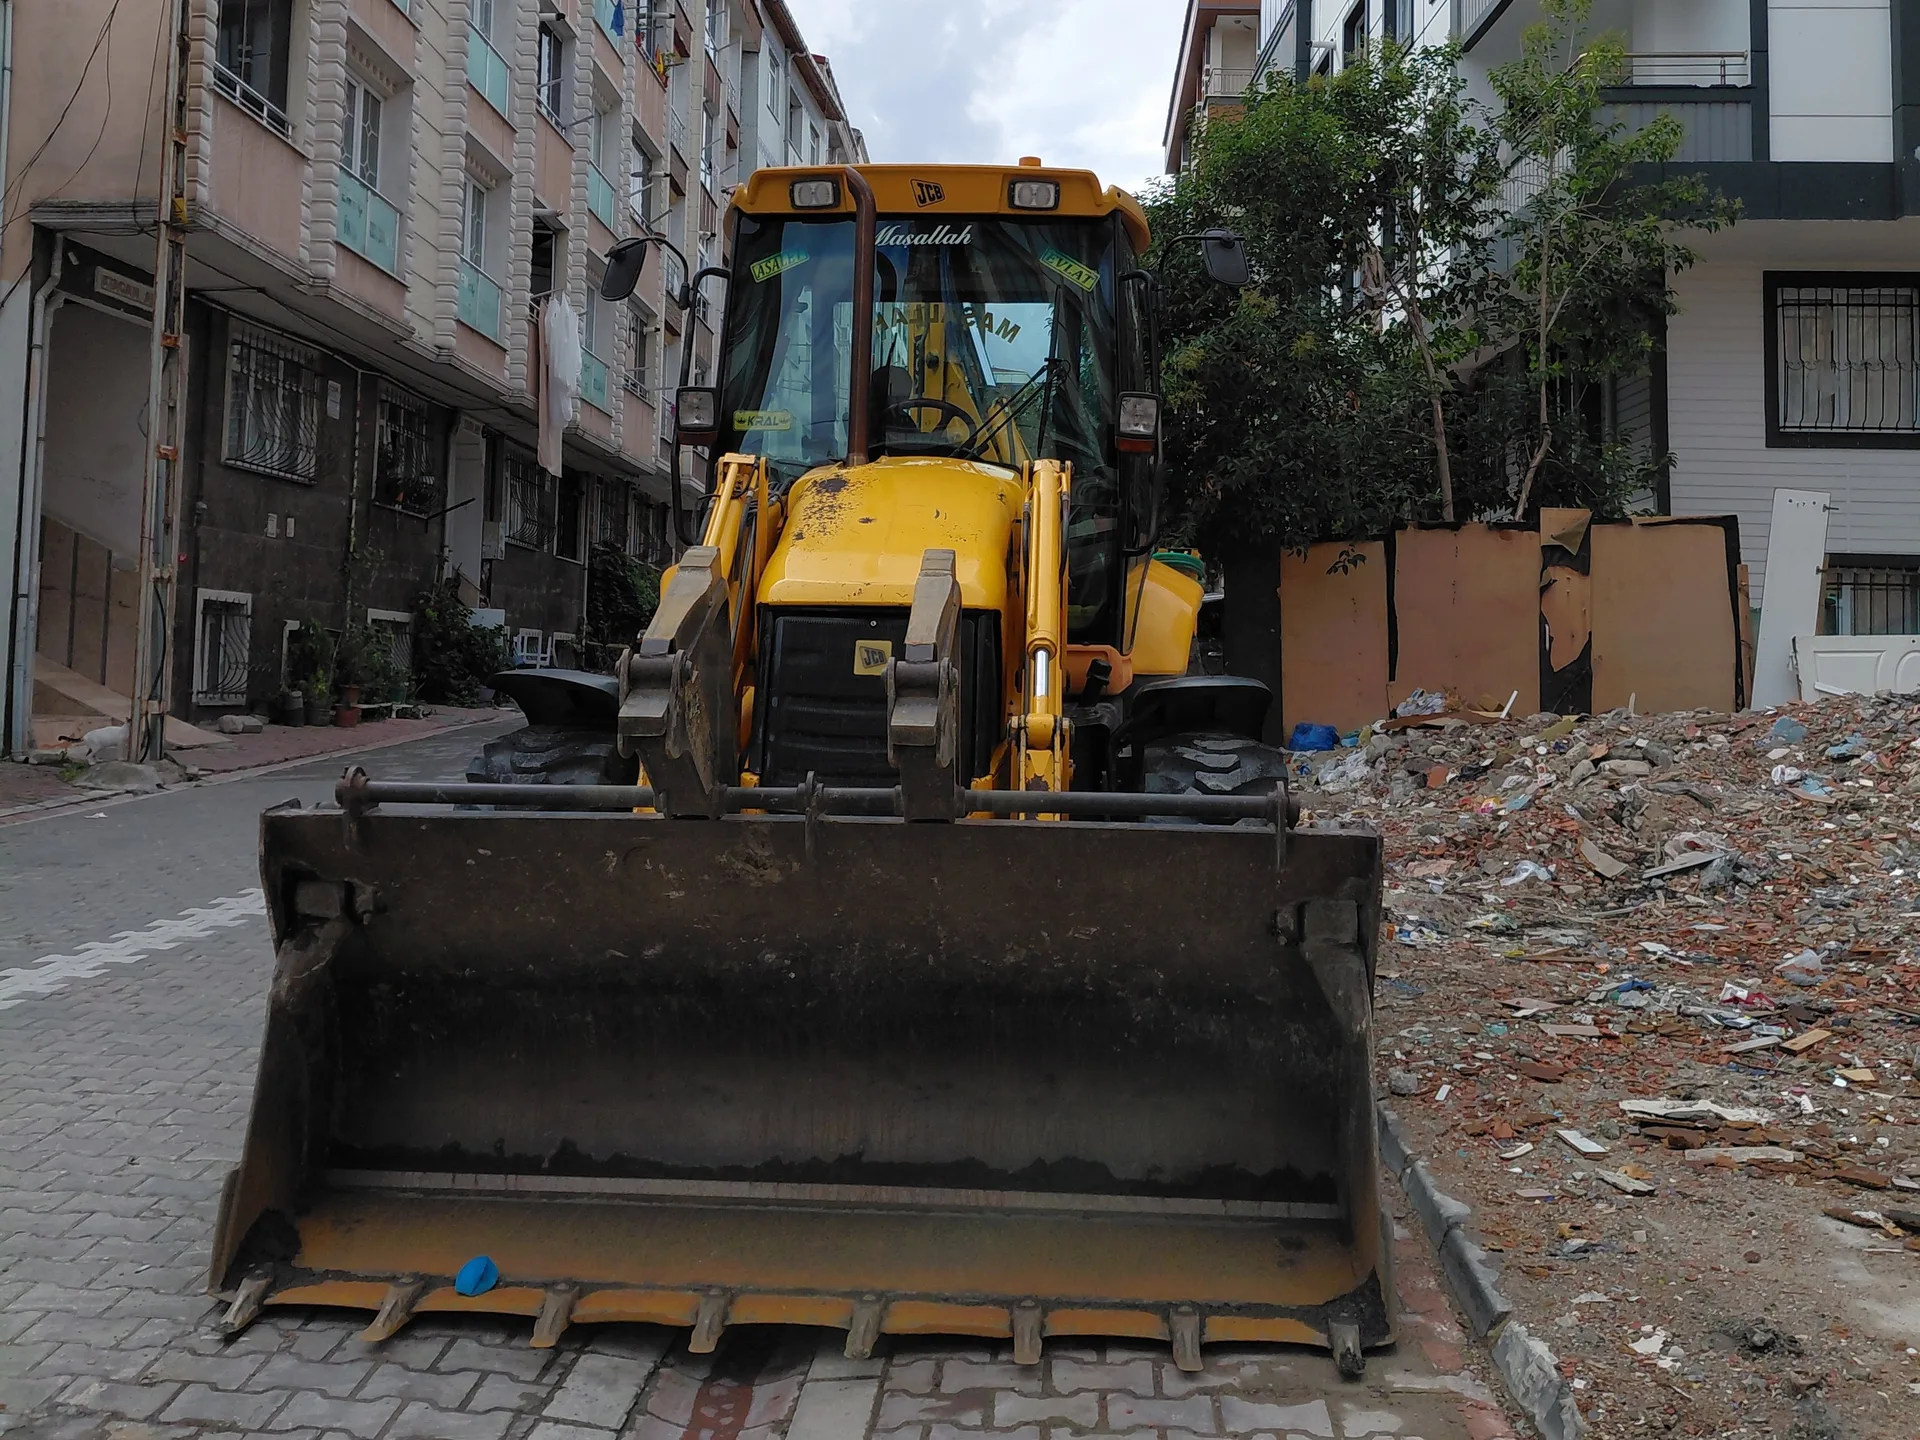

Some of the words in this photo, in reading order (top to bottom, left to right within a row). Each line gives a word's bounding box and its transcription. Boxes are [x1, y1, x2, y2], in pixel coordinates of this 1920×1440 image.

[916, 181, 944, 205] JCB
[1045, 250, 1096, 285] EVLAT
[746, 415, 780, 427] KRAL
[862, 647, 886, 667] JCB
